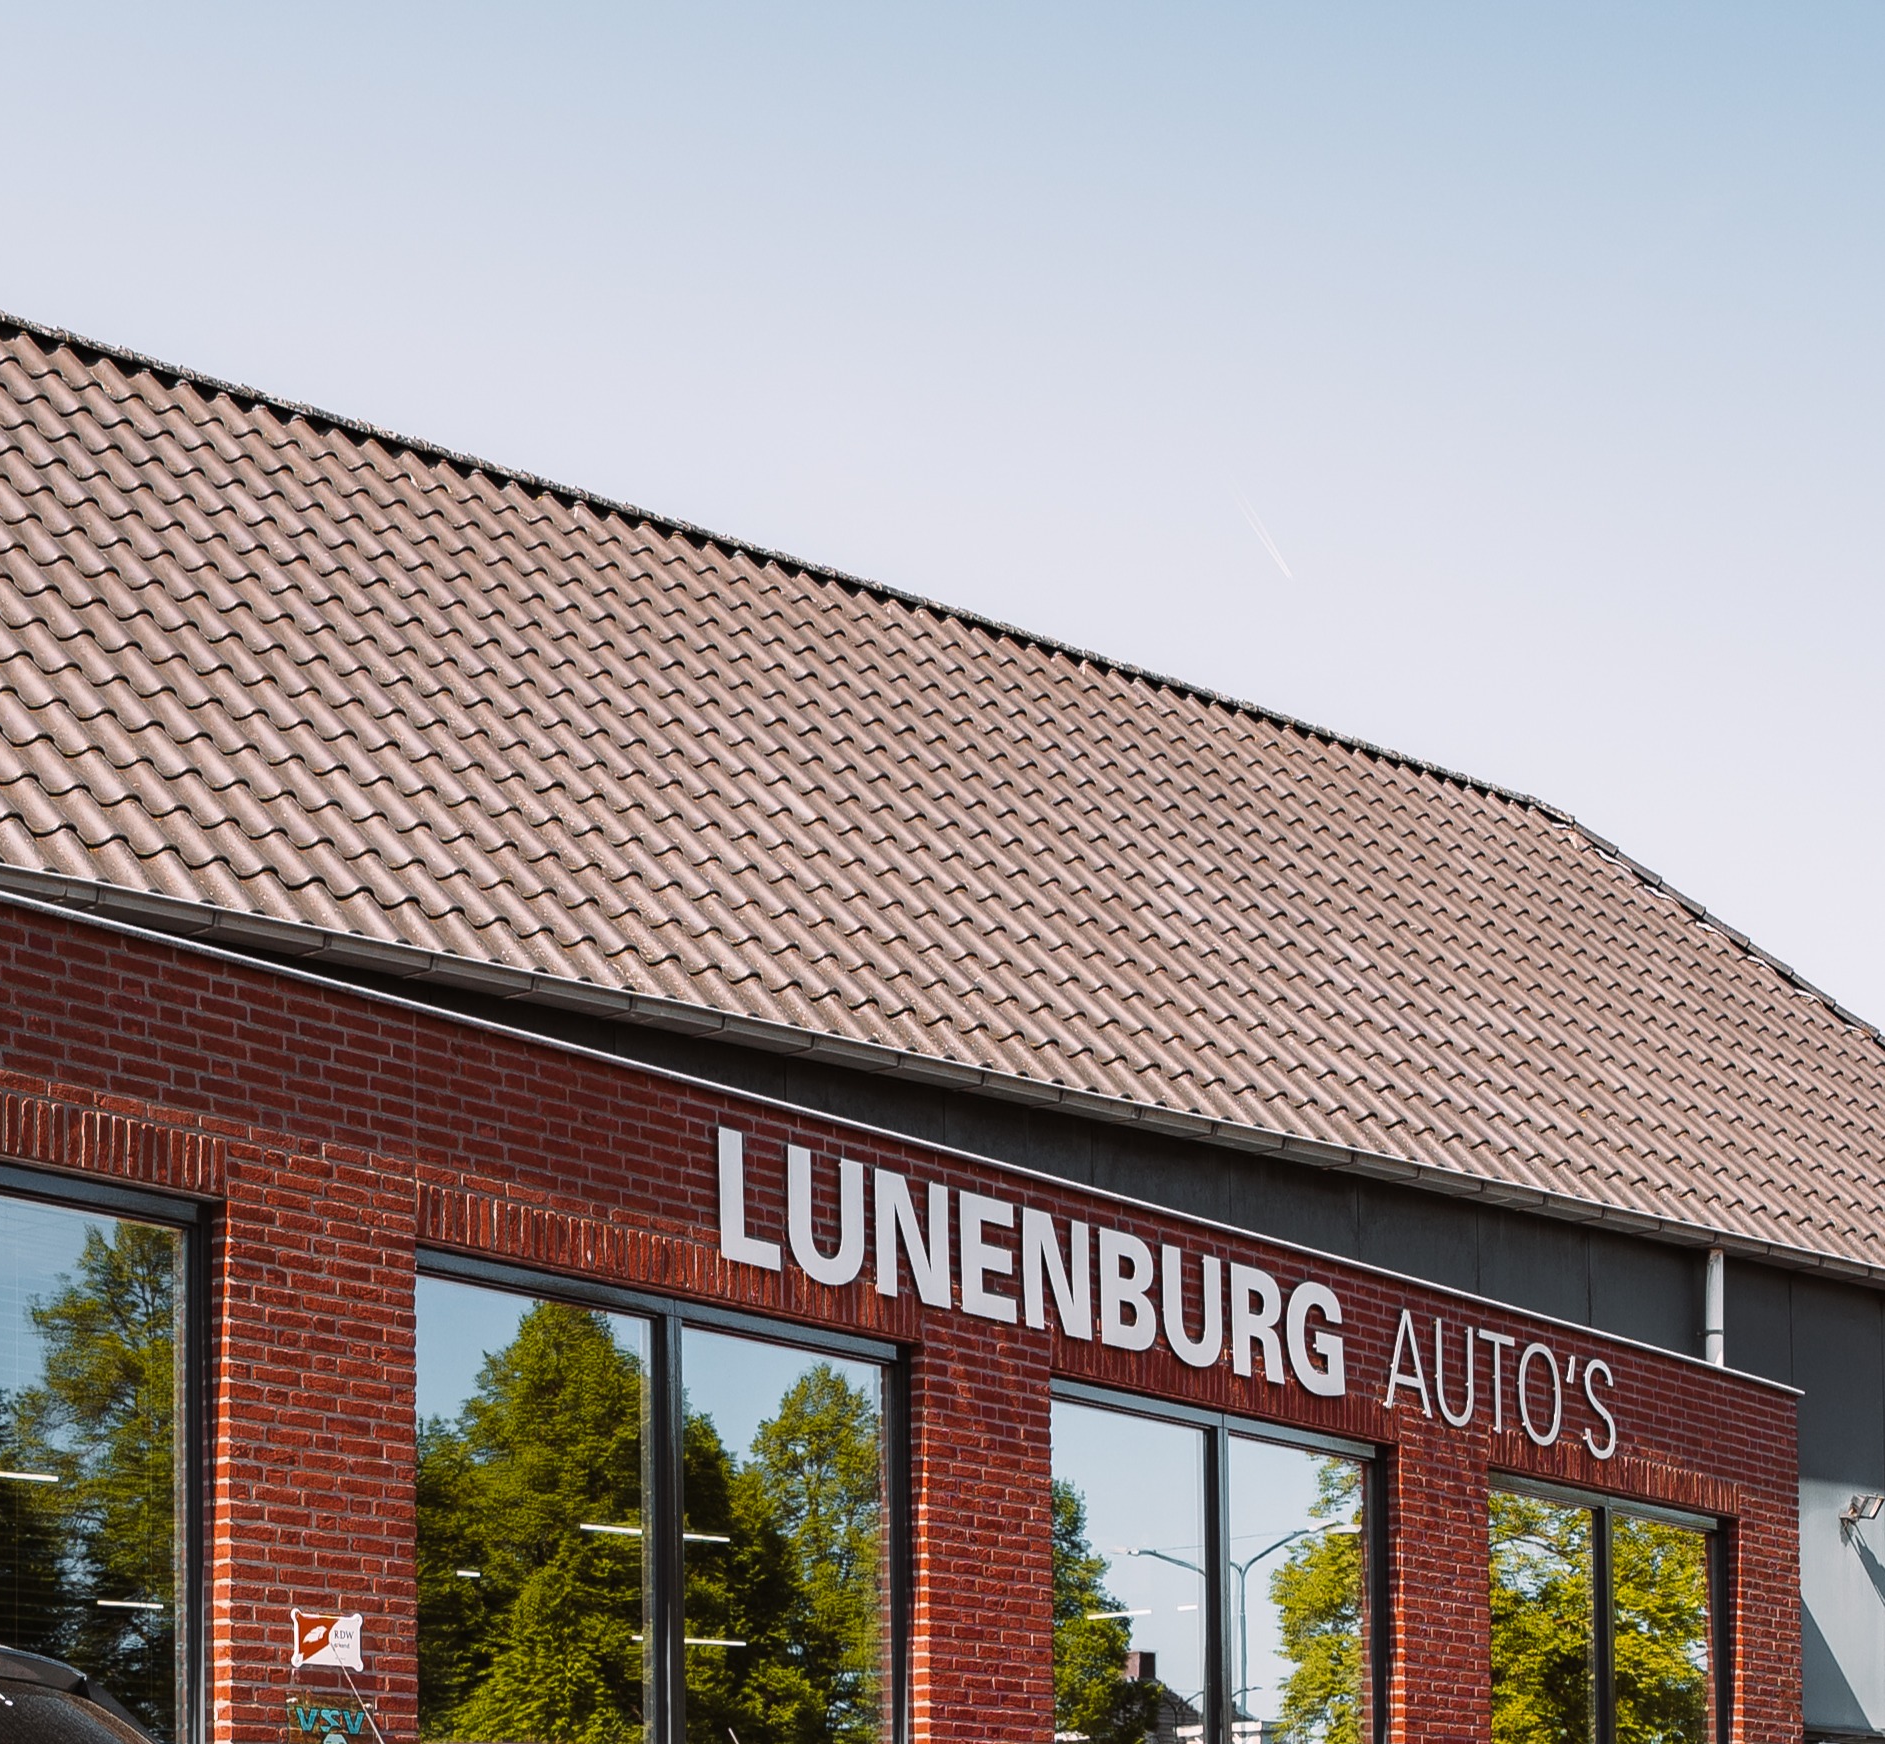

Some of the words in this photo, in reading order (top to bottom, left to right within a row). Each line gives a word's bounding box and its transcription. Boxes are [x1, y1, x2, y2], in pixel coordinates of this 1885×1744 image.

[718, 1127, 1346, 1397] LUNENBURG
[1383, 1308, 1617, 1460] AUTO'S
[334, 1629, 355, 1640] RDW
[295, 1706, 365, 1735] VSV
